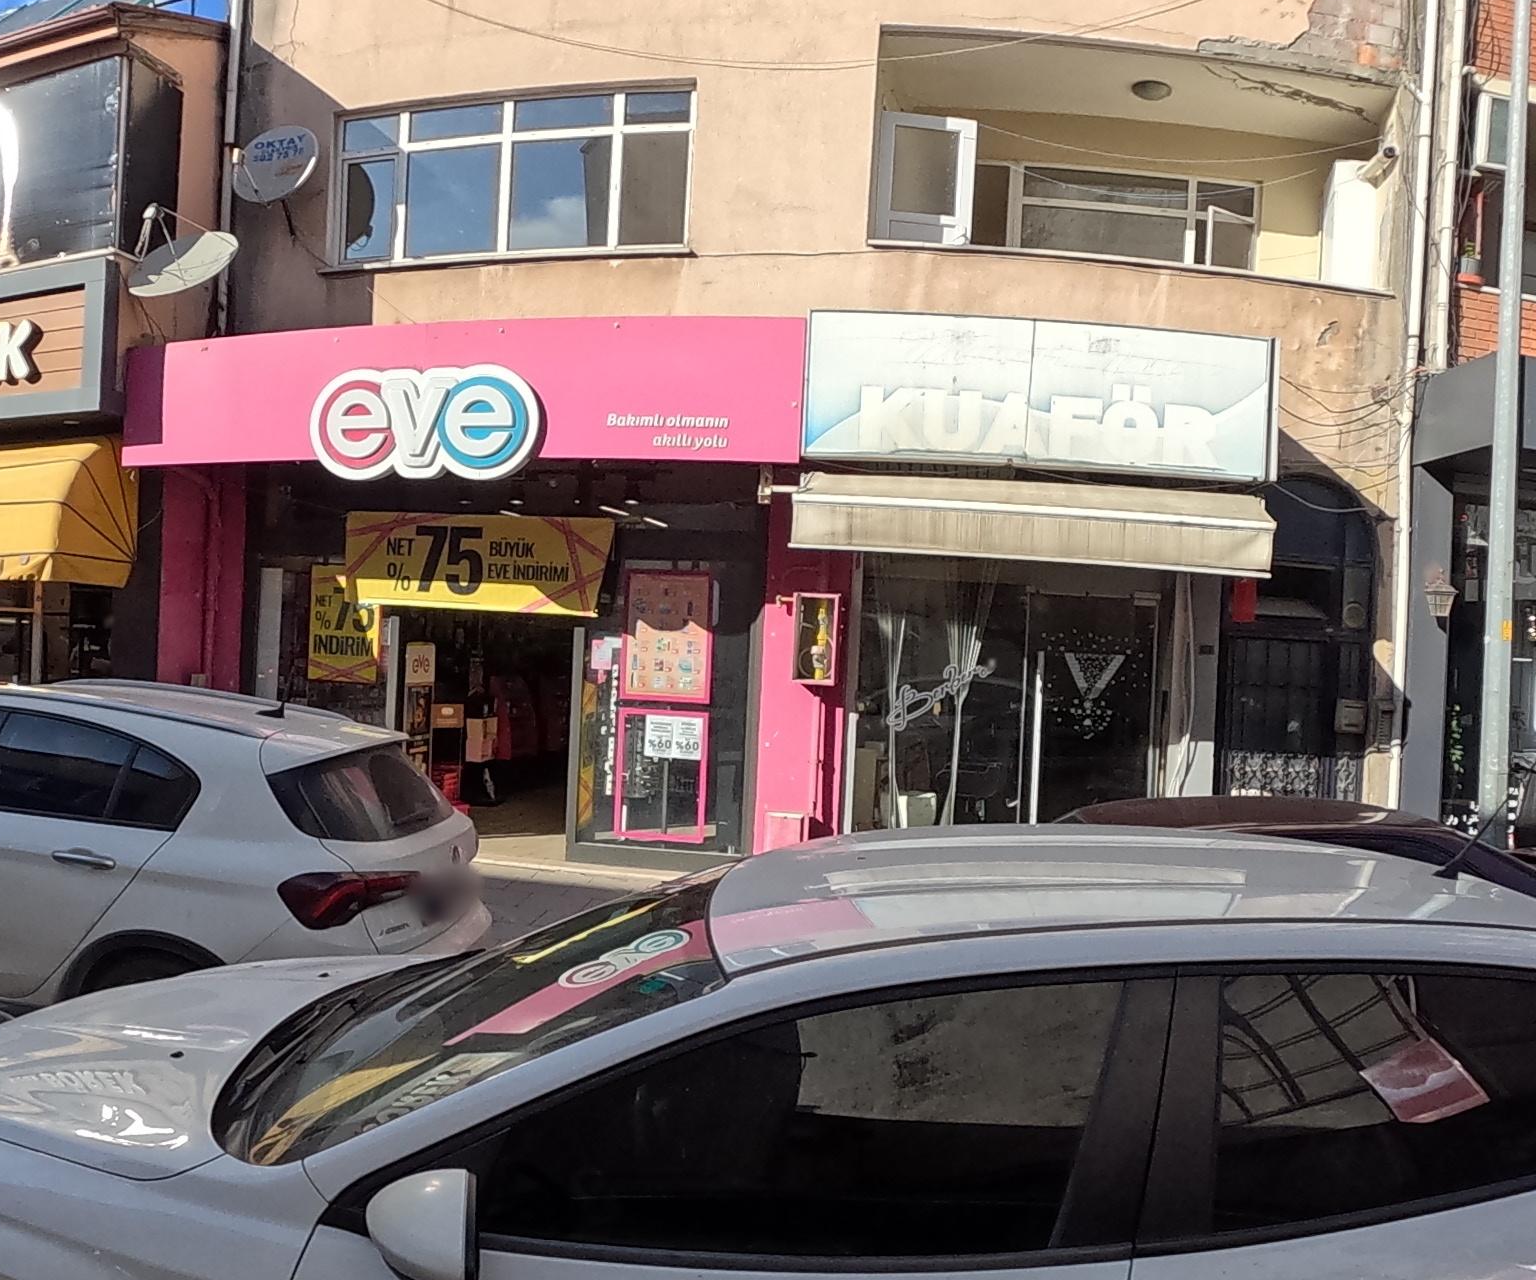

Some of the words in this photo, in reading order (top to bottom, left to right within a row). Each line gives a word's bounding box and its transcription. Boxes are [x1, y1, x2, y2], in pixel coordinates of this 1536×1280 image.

[321, 373, 524, 470] eve
[607, 413, 664, 428] Bakımlı
[665, 414, 729, 430] olmanın
[860, 383, 1227, 471] KUAFÖR
[653, 433, 693, 448] akıllı
[694, 435, 729, 450] yolu
[386, 538, 415, 557] NET
[488, 537, 535, 558] BÜYÜK
[415, 525, 485, 597] 75
[487, 562, 510, 580] EVE
[512, 561, 570, 583] İNDİRİMİ
[314, 594, 333, 608] NET
[312, 633, 375, 658] İNDİRİM
[411, 652, 431, 674] eve
[675, 740, 700, 751] %60
